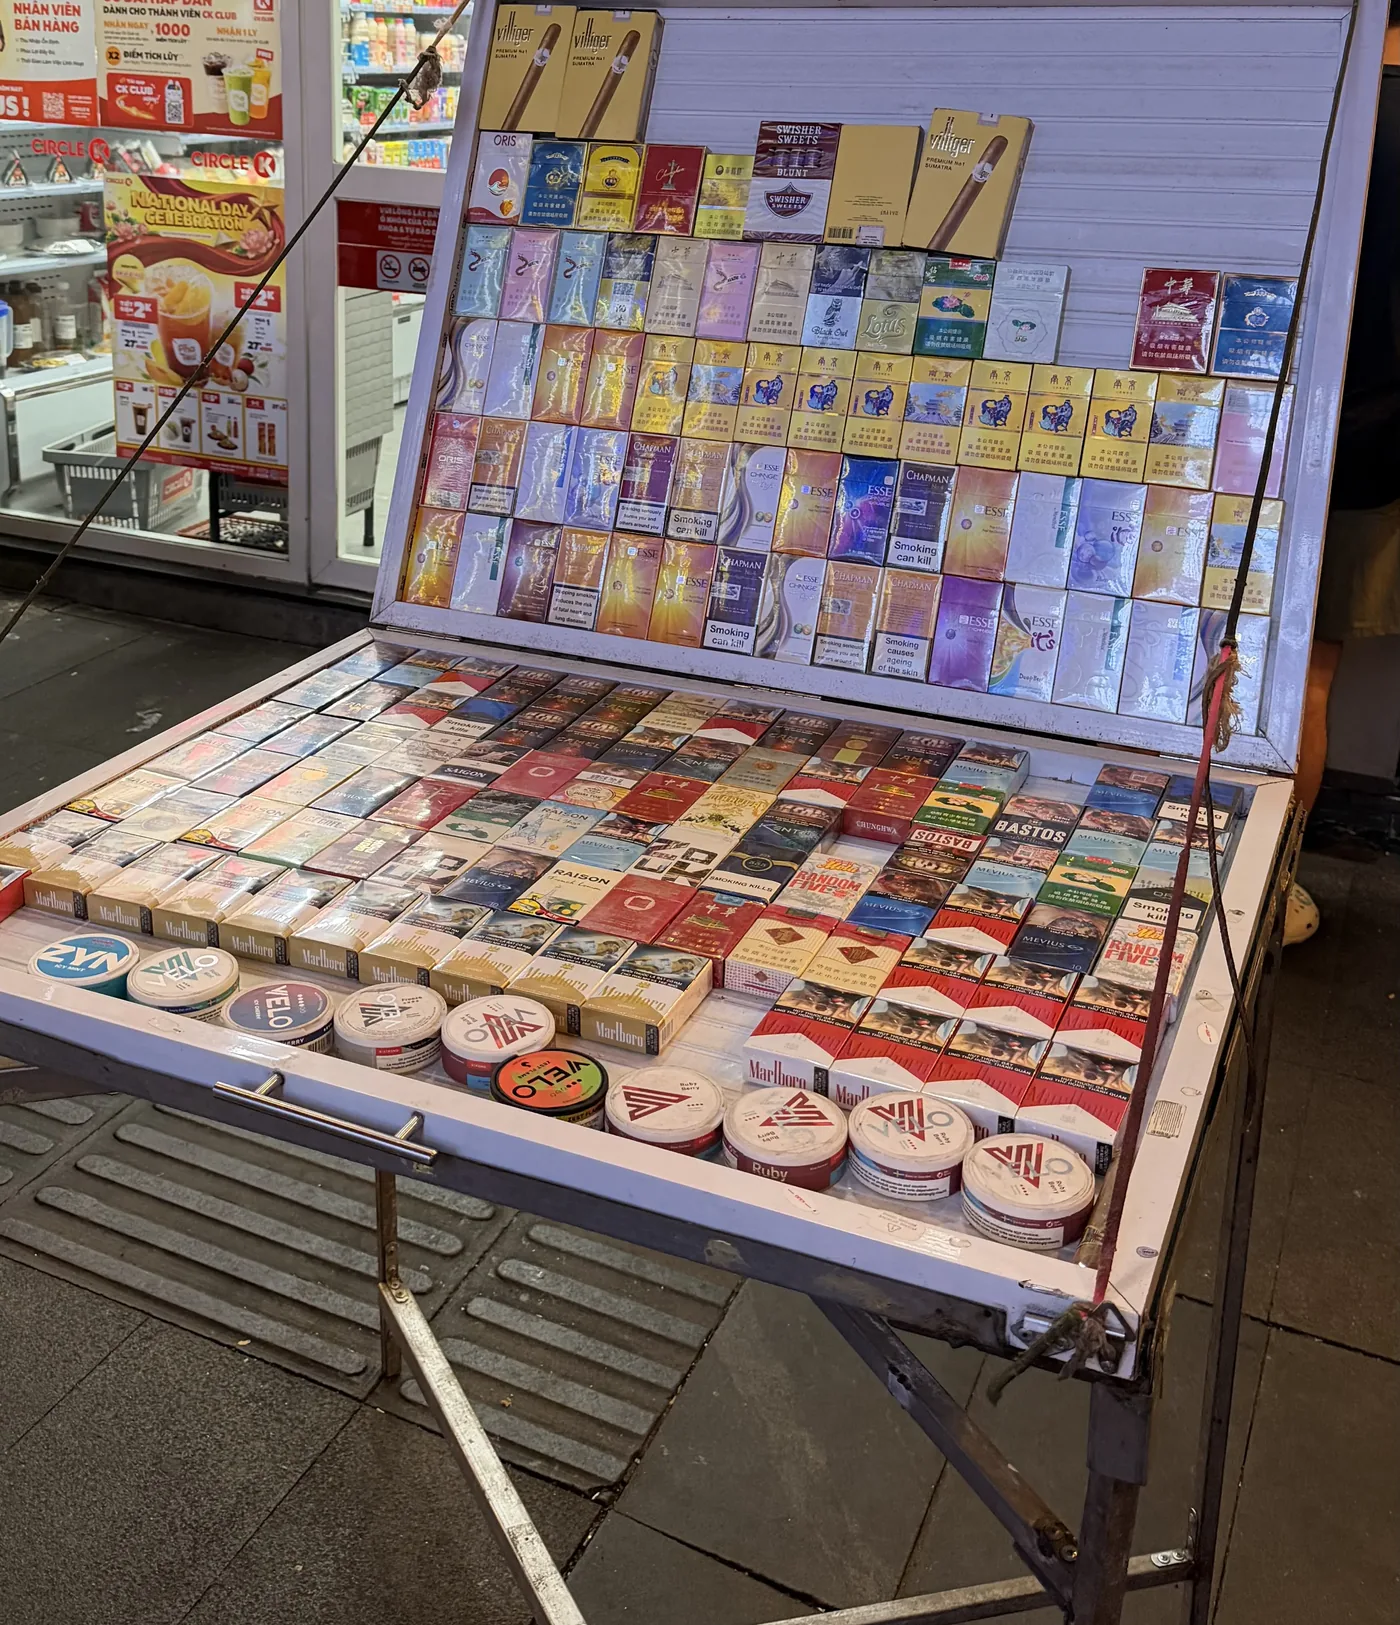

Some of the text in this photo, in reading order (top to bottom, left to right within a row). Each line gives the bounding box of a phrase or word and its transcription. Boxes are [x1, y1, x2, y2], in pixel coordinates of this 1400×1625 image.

[13, 1, 81, 16] NHÂN VIÊN
[103, 4, 127, 14] DÀNH
[129, 7, 146, 15] CHO
[148, 6, 178, 17] THÀNH
[180, 8, 200, 18] VIÊN
[202, 11, 213, 19] CK
[43, 18, 79, 33] HÀNG
[155, 23, 190, 36] 1000
[497, 11, 534, 46] villiger
[574, 18, 612, 54] villiger
[108, 51, 119, 60] X2
[776, 125, 821, 135] SWISHER
[931, 116, 976, 158] villiger
[494, 134, 516, 146] ORIS
[778, 135, 818, 145] SWEETS
[31, 138, 85, 158] CIRCLE
[191, 151, 249, 170] CIRCLE
[925, 163, 952, 171] SUMATRA
[926, 157, 953, 165] PREMIUM
[777, 168, 808, 177] BLUNT
[130, 190, 250, 218] NATIONAL DAY
[769, 195, 806, 204] SWISHER
[146, 212, 244, 231] CELEBRATION
[812, 326, 848, 337] Black Owl
[906, 470, 949, 484] CHAPMAN
[810, 487, 833, 497] ESSE
[868, 485, 892, 497] ESSE
[674, 514, 712, 528] Smoking
[695, 526, 707, 536] kill
[894, 541, 937, 556] Smoking
[723, 556, 762, 570] CHAPMAN
[897, 554, 932, 565] can kill
[686, 577, 708, 588] ESSE
[833, 570, 874, 584] CHAPMAN
[891, 578, 932, 591] CHAPMAN
[969, 616, 994, 629] ESSE
[1032, 616, 1057, 628] ESSE
[710, 624, 750, 640] Smoking
[712, 637, 728, 646] can
[885, 637, 919, 649] Smoking
[1031, 630, 1055, 652] it's
[887, 648, 914, 657] causes
[887, 656, 912, 667] ageing
[888, 665, 901, 673] the
[903, 668, 918, 677] skin
[443, 718, 488, 732] Smoking
[449, 726, 470, 734] kills
[556, 735, 600, 749] CAMEL
[769, 732, 814, 746] CAMEL
[891, 753, 940, 767] CAMEL
[443, 766, 488, 778] SAIGON
[954, 764, 987, 774] MEVIUS
[332, 791, 362, 800] MEVIUS
[542, 807, 589, 820] RAISON
[856, 820, 897, 834] CHUNGHWA
[994, 820, 1067, 844] BASTOS
[581, 840, 613, 850] MEVIUS
[915, 829, 973, 850] BASTOS
[1078, 834, 1116, 845] MEVIUS
[554, 869, 610, 885] RAISON
[977, 866, 1014, 879] MEVIUS
[460, 876, 495, 888] MEVIUS
[710, 876, 773, 892] SMOKING KILLS
[795, 870, 862, 891] RANDOM
[35, 890, 72, 913] Marlboro
[863, 902, 901, 912] MEVIUS
[100, 905, 139, 927] Marlboro
[165, 921, 206, 943] Marlboro
[232, 936, 273, 958] Marlboro
[1023, 936, 1065, 949] MEVIUS
[38, 943, 128, 972] ZYN
[302, 949, 345, 972] Marlboro
[146, 954, 219, 987] VELO
[264, 985, 293, 1029] VELO
[595, 1022, 644, 1048] Marlboro
[512, 1060, 590, 1099] VELO
[750, 1059, 806, 1089] Marlboro
[867, 1111, 954, 1138] VELO
[752, 1162, 788, 1182] Ruby
